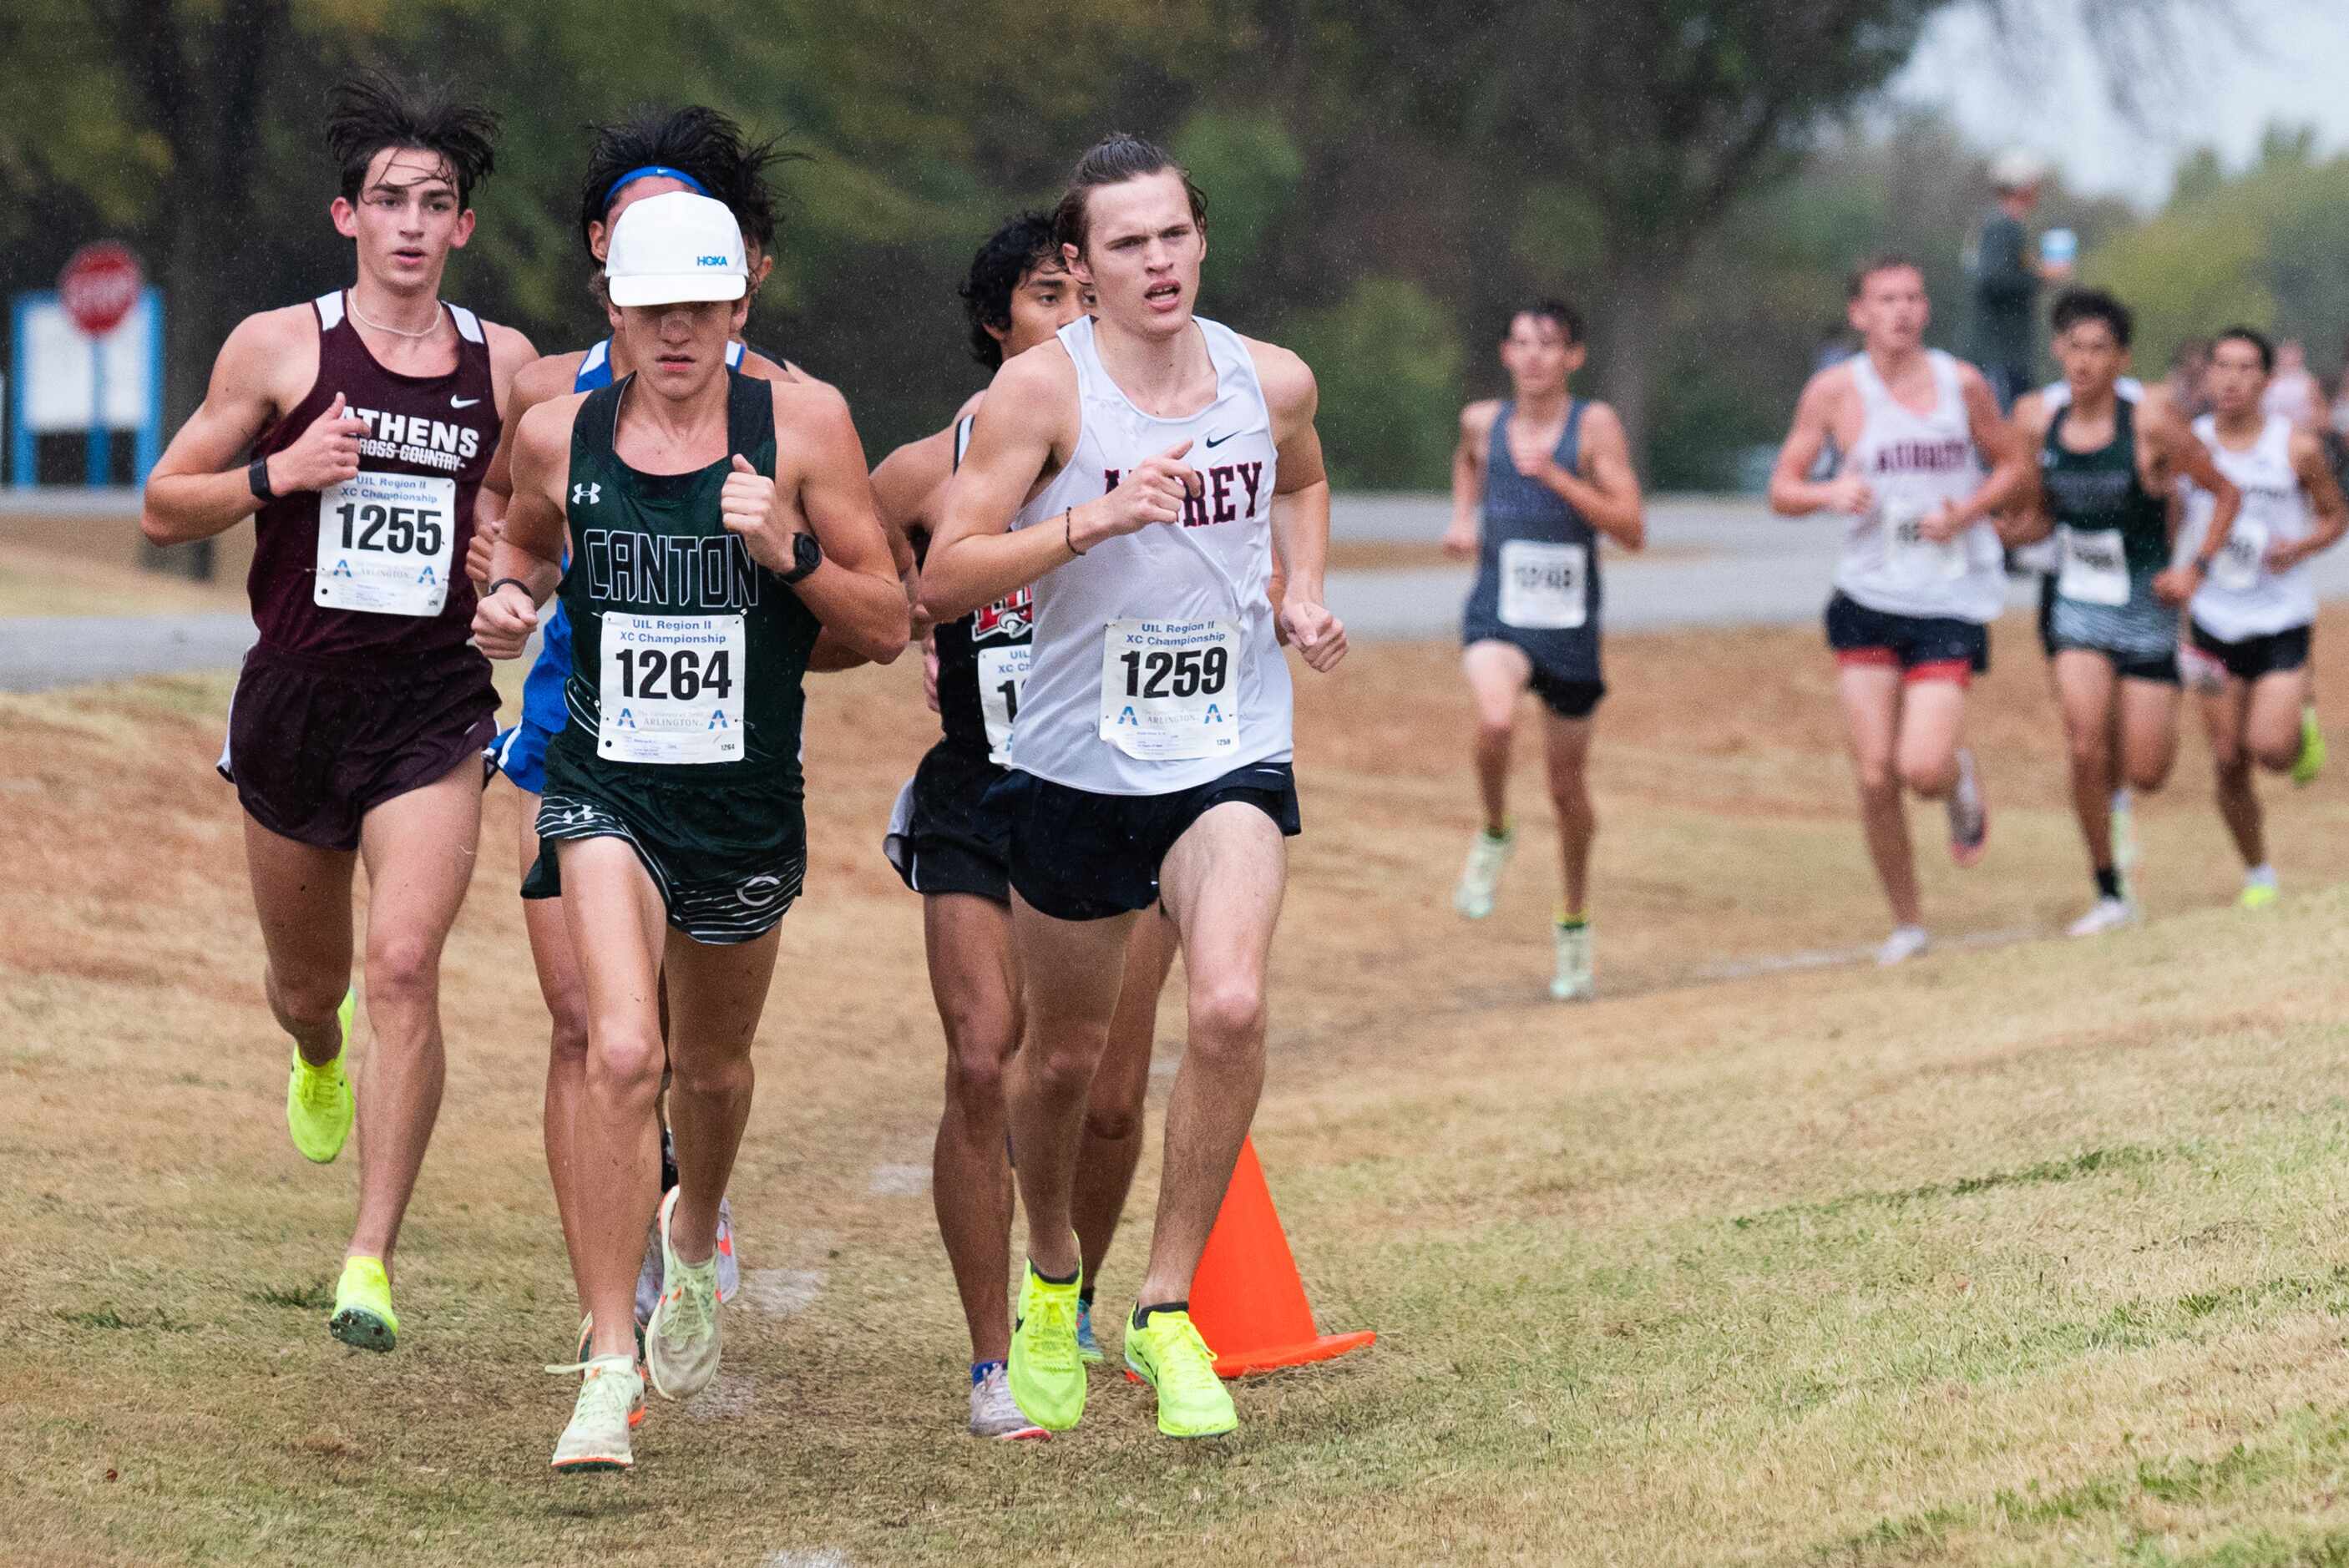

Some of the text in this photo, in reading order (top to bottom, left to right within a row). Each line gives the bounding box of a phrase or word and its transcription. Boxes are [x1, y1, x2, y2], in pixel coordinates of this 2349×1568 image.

[696, 256, 727, 266] HOKA
[357, 475, 375, 485] UIL
[380, 477, 416, 488] Region
[341, 487, 437, 503] XC Championship
[337, 503, 442, 555] 1255
[584, 529, 758, 608] CANTON
[633, 620, 652, 629] UIL
[657, 620, 701, 632] Region
[1142, 624, 1162, 633] UIL
[1166, 624, 1201, 635] Region
[620, 631, 726, 645] XC Championship
[1126, 631, 1226, 646] XC Championship
[615, 649, 732, 701] 1264
[1120, 645, 1228, 699] 1259
[643, 718, 698, 726] ARLINGTON
